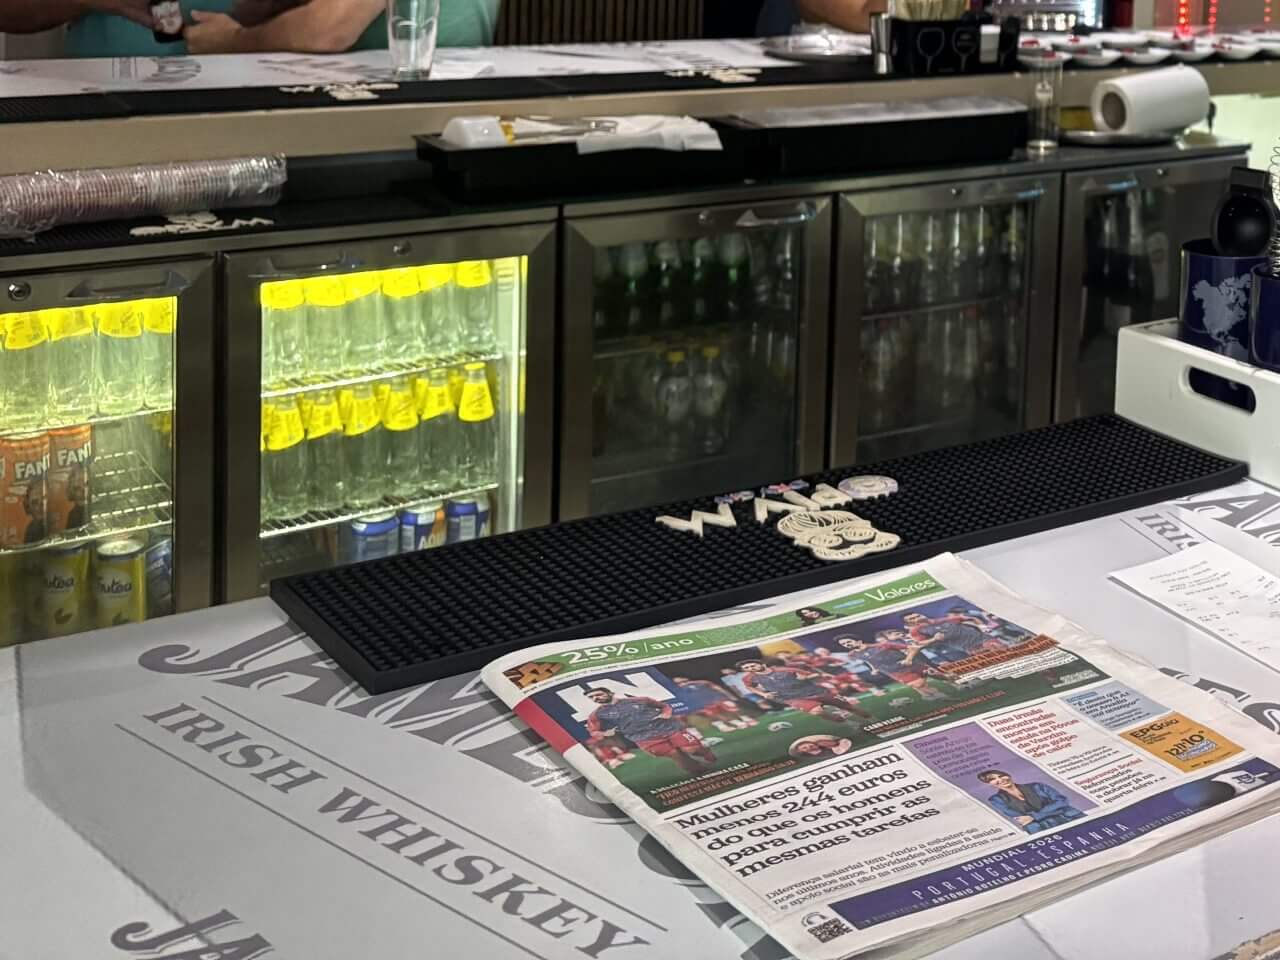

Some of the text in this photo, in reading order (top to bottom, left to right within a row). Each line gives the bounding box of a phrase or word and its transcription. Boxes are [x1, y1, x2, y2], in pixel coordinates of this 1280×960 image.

[864, 577, 936, 602] Valores
[561, 643, 639, 665] 25%
[673, 786, 801, 830] Mulheres
[802, 752, 904, 793] ganham
[690, 769, 909, 840] menos 244 euros
[707, 780, 932, 851] do que os homens
[143, 702, 651, 959] IRISH WHISKEY
[720, 795, 931, 867] para cumprir as
[735, 808, 941, 878] mesmas tarefas
[912, 858, 1022, 900] PORTUGAL
[1041, 822, 1131, 860] ESPANHA
[961, 847, 1028, 873] MUNDIAL
[1030, 833, 1064, 851] 2026
